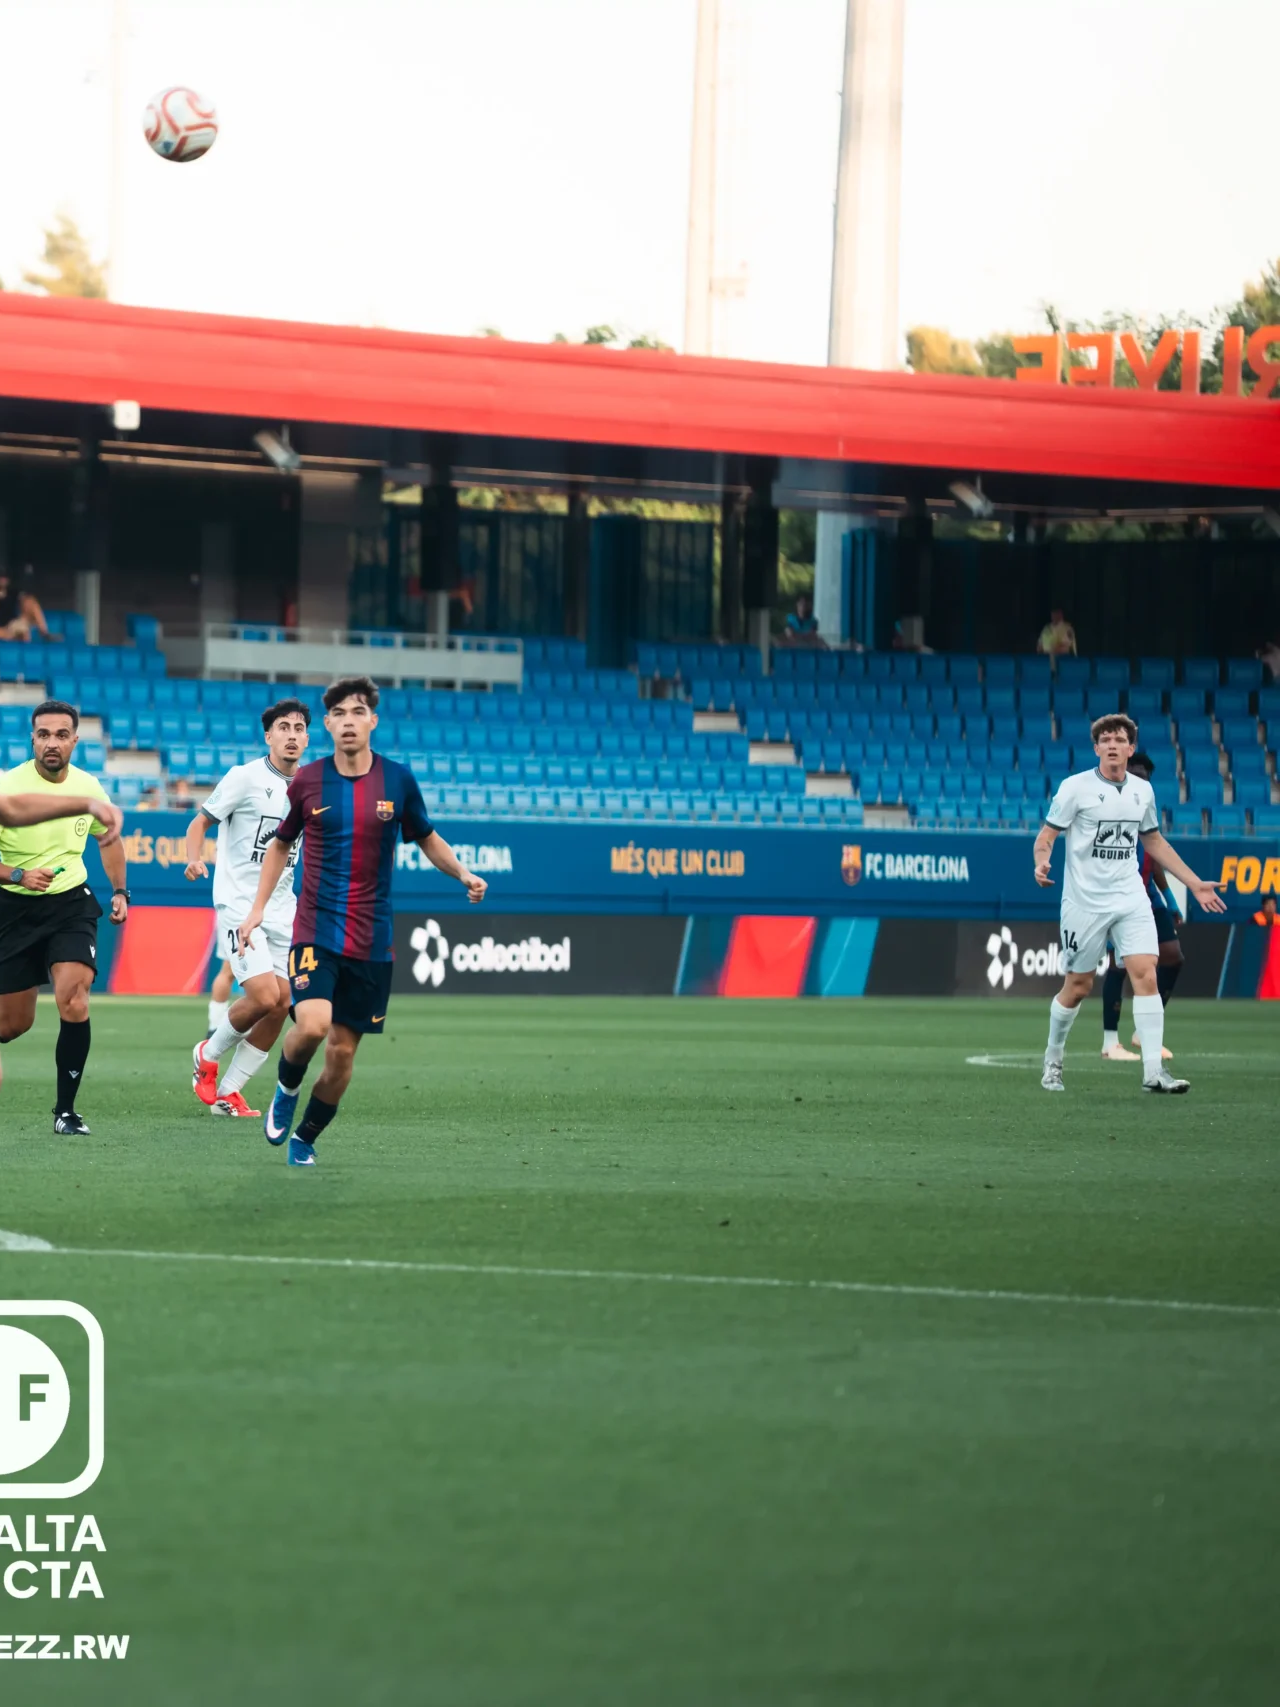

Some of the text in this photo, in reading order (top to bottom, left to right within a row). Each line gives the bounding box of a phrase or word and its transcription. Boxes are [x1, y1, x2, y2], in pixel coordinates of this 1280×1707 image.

[396, 841, 419, 871] FC
[611, 840, 745, 880] MÉS QUE UN CLUB
[864, 852, 970, 882] FC BARCELONA
[451, 936, 571, 972] collectibol
[1063, 929, 1078, 953] 14
[288, 946, 319, 978] 14
